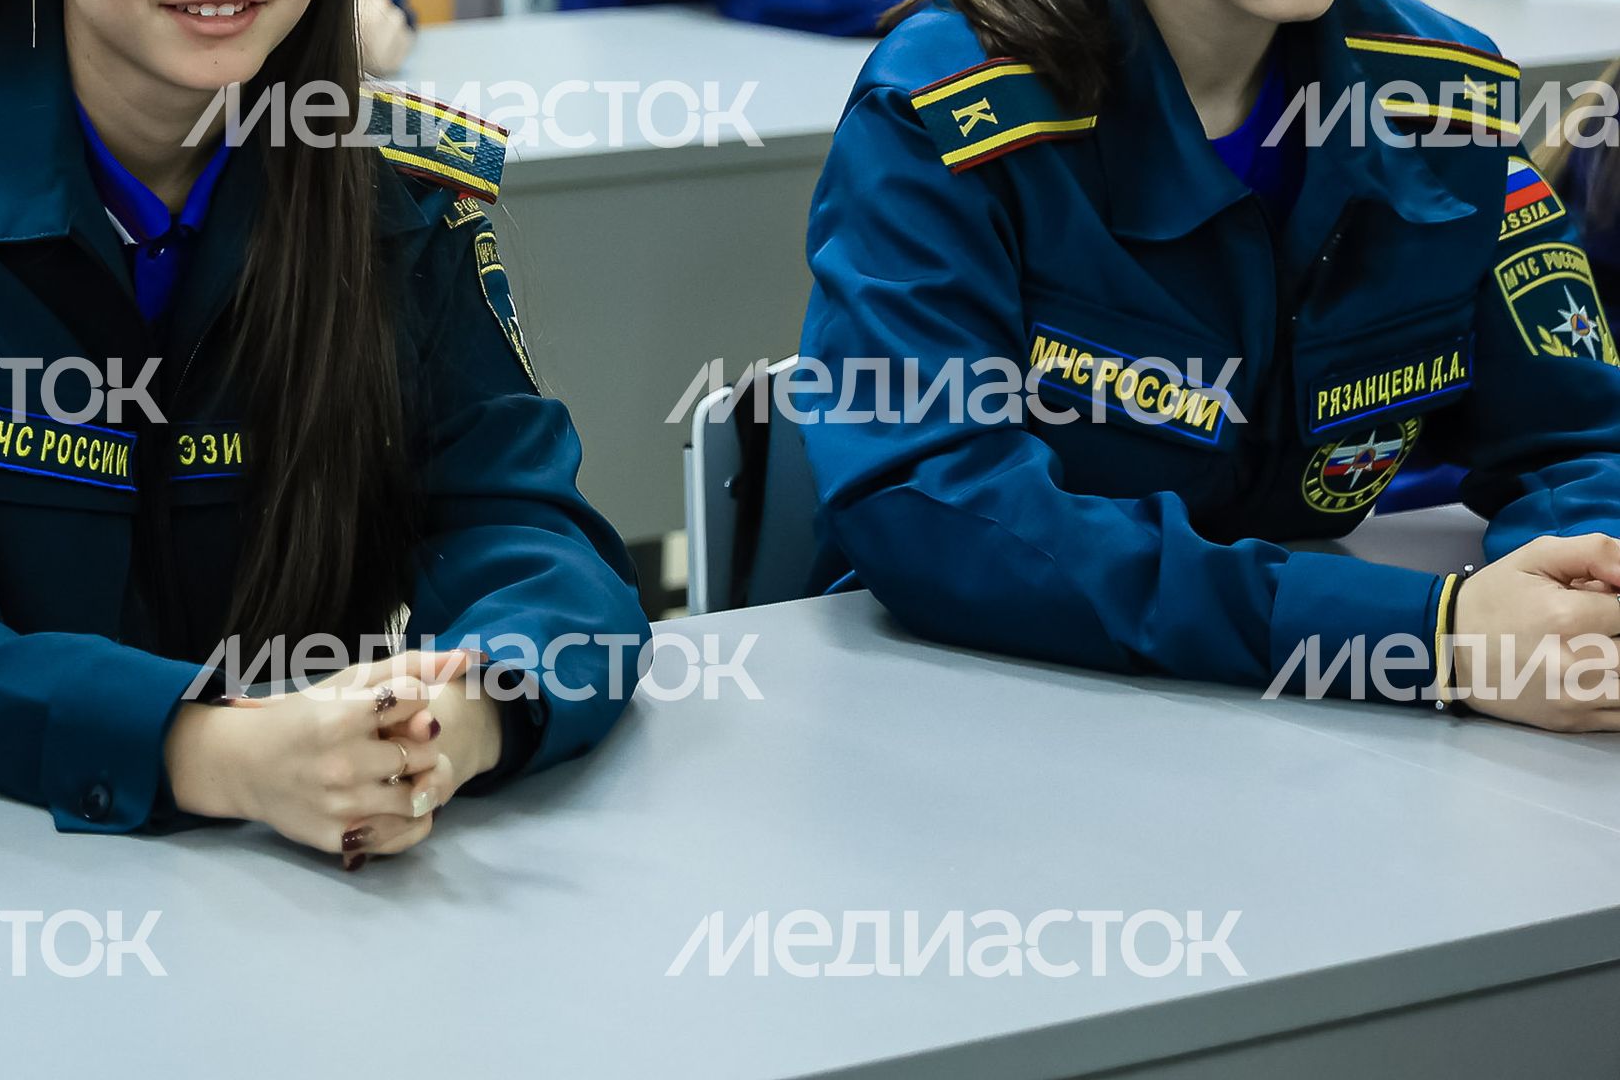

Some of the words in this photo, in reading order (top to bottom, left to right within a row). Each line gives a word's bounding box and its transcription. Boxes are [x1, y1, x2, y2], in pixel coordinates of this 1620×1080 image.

[1502, 256, 1541, 291] МЧС
[1029, 334, 1095, 386] МЧС
[1093, 360, 1222, 432] РОССИИ
[1317, 361, 1427, 421] РЯЗАНЦЕВА
[1429, 350, 1467, 393] Д.А.
[39, 428, 130, 478] РОССИИ
